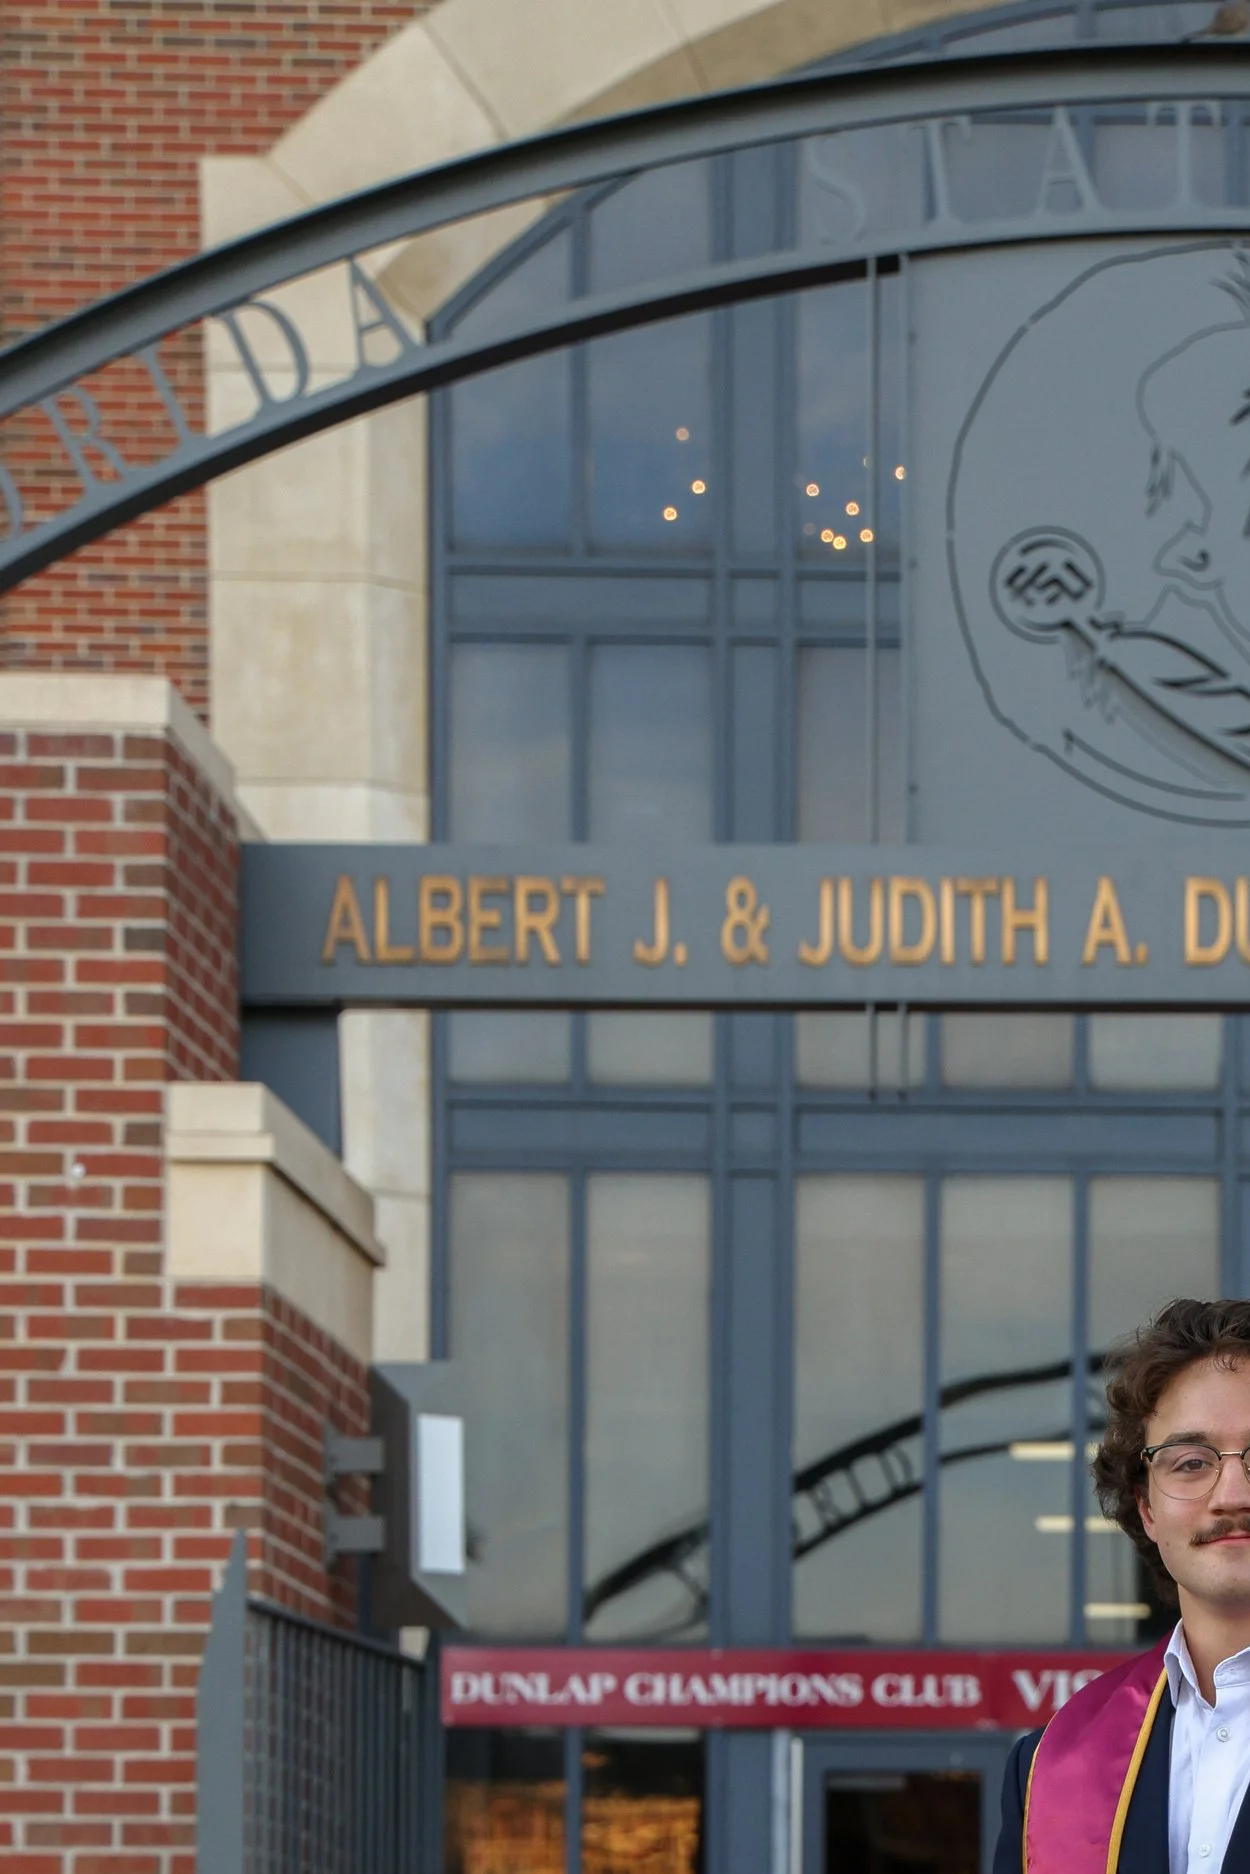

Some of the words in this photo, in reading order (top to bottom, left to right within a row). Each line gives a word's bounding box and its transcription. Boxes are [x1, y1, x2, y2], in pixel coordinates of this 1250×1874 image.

[320, 873, 606, 967] ALBERT
[632, 875, 689, 968] J.
[719, 874, 771, 968] &
[797, 875, 1048, 968] JUDITH
[1082, 875, 1149, 966] A.
[449, 1670, 616, 1708] DUNLAP
[623, 1671, 864, 1709] CHAMPIONS
[870, 1672, 981, 1709] CLUB
